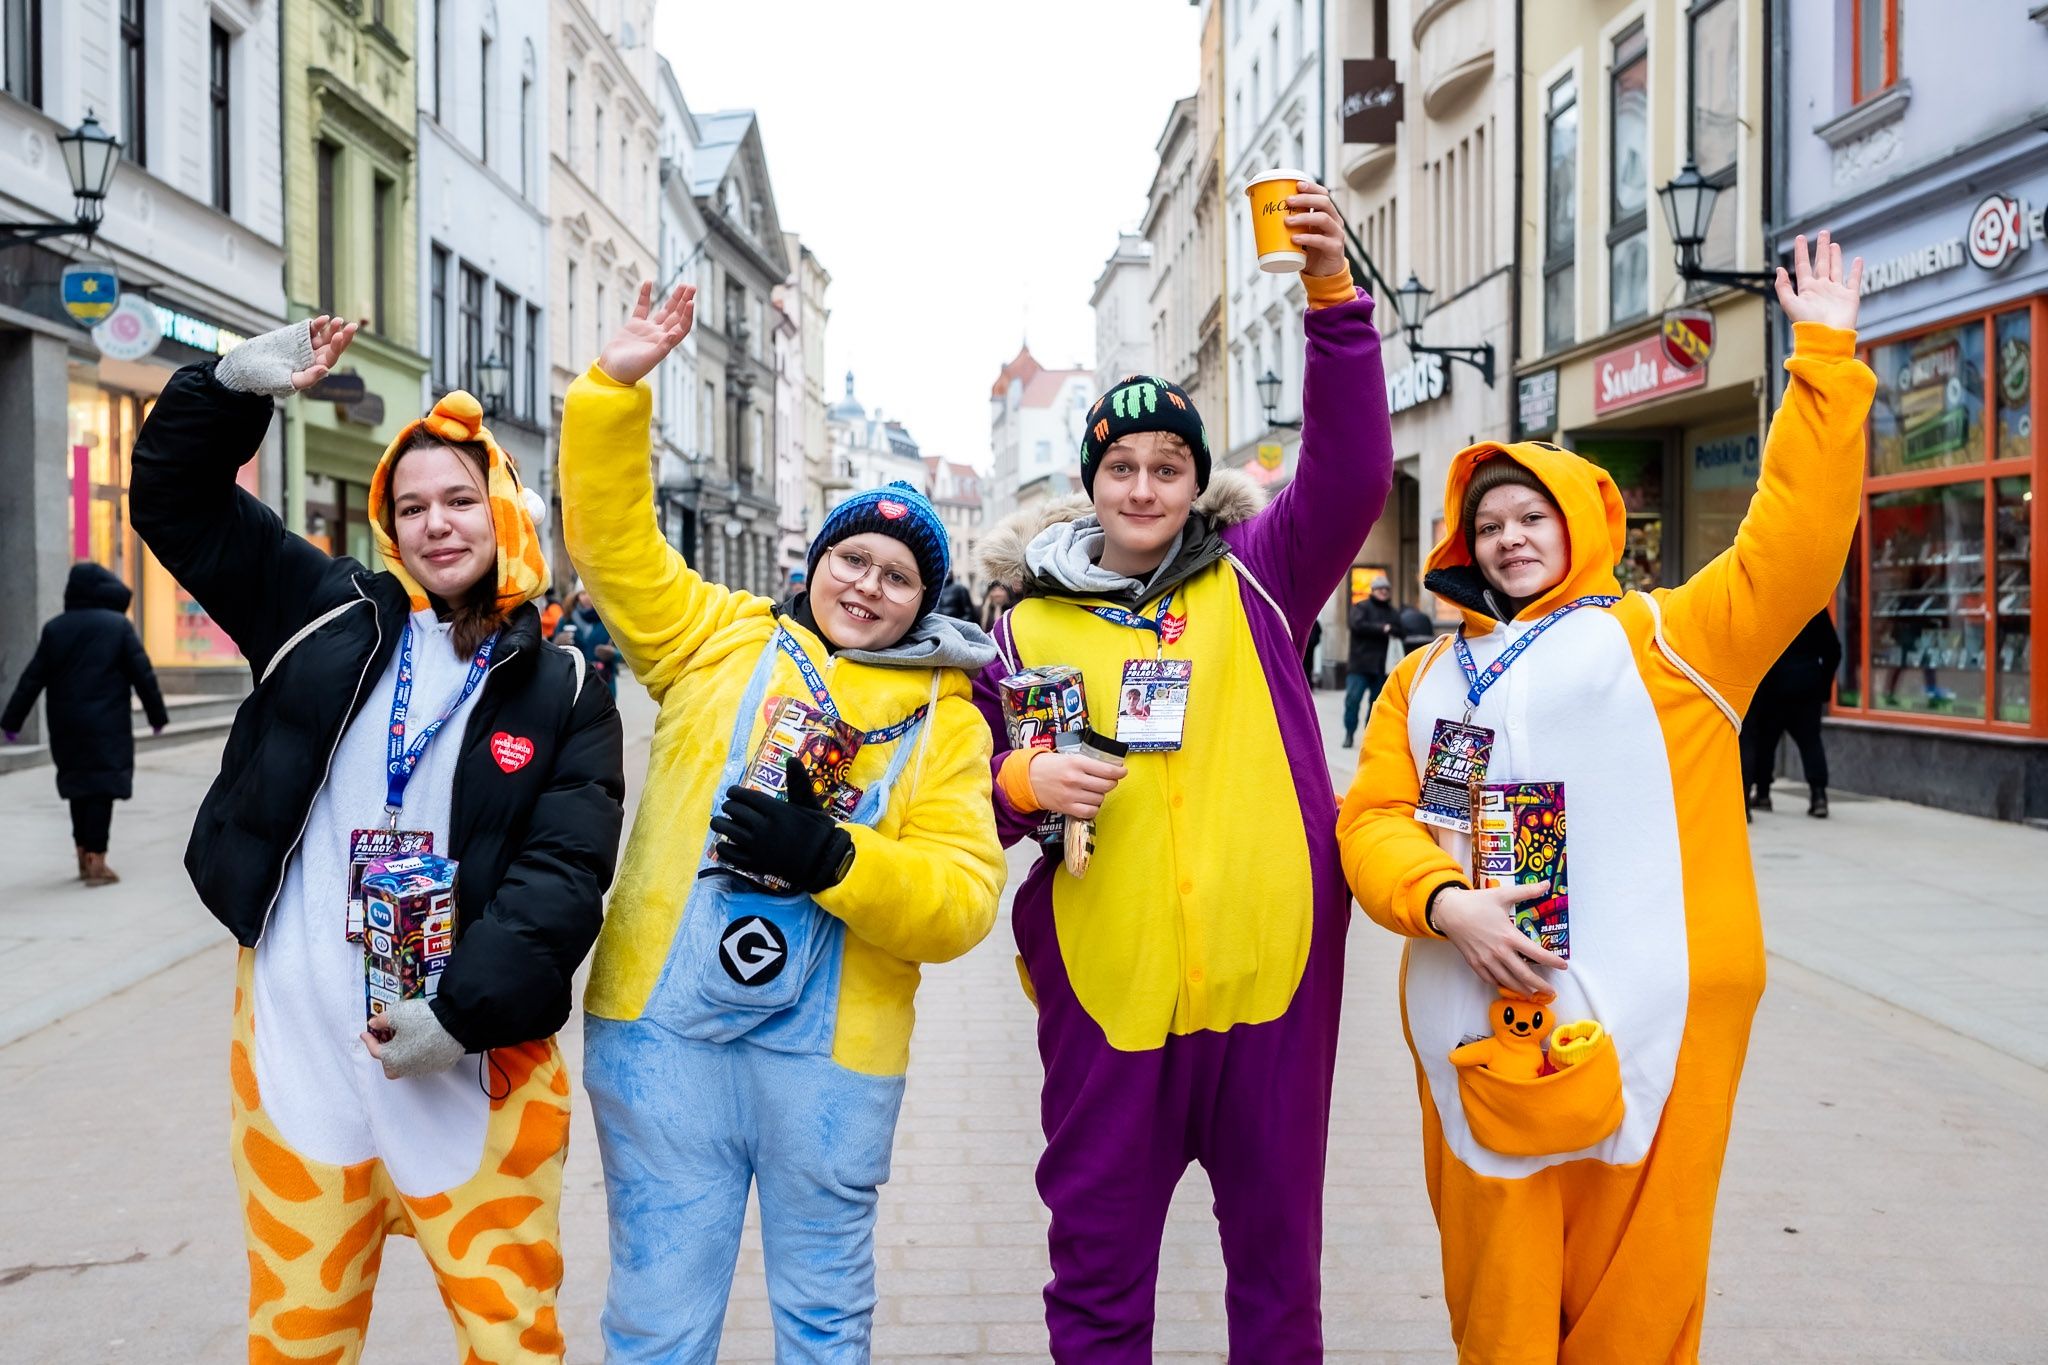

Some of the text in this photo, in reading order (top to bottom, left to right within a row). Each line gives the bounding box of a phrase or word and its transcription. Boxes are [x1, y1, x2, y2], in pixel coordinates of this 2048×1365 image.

[479, 645, 492, 657] 112
[1128, 662, 1138, 671] A
[1163, 664, 1184, 678] 34
[1480, 672, 1494, 687] 112
[1067, 696, 1078, 707] tvn
[394, 707, 407, 721] 112
[1450, 739, 1472, 754] 34
[1442, 756, 1450, 767] A
[1037, 822, 1063, 832] SWOJE
[358, 834, 369, 844] A
[400, 836, 425, 853] 34
[373, 907, 389, 921] tvn
[721, 917, 784, 982] G
[431, 959, 447, 969] PL
